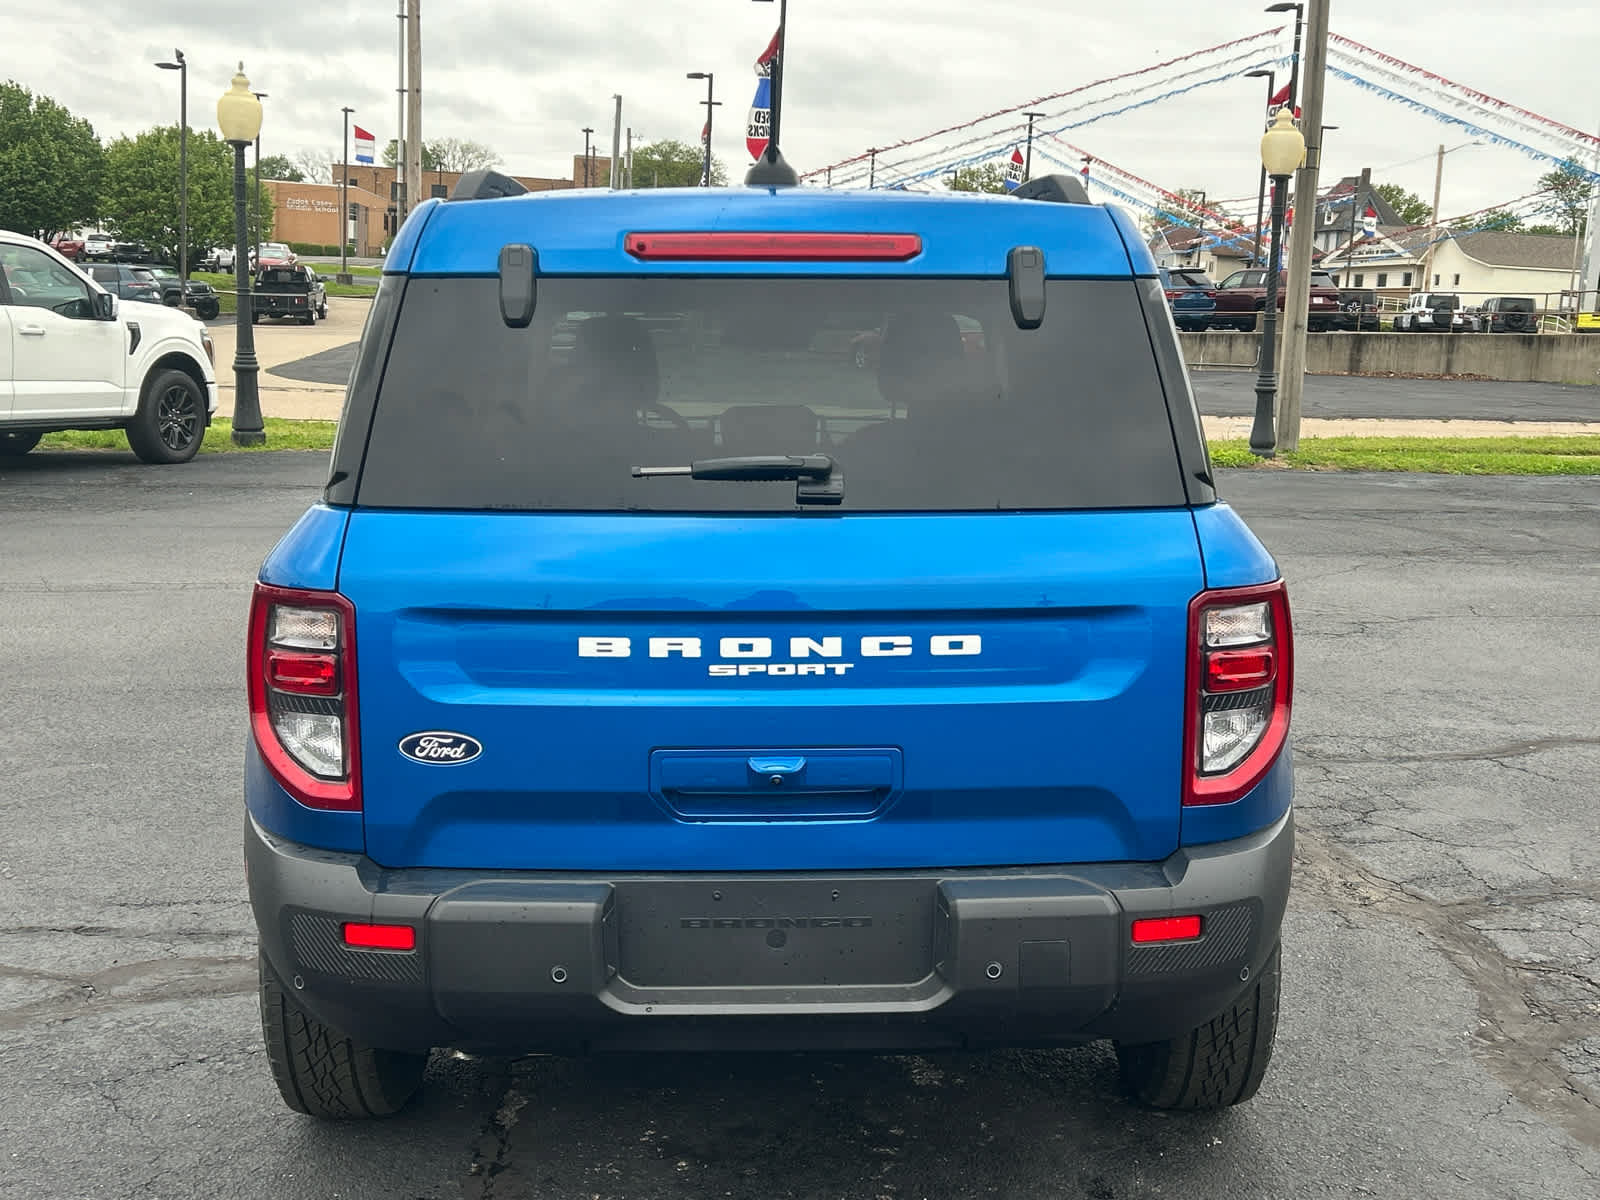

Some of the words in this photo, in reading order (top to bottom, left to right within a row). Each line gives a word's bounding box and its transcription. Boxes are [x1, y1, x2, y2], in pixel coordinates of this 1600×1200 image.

[578, 635, 982, 658] BRONCO
[708, 663, 854, 677] SPORT
[415, 736, 466, 758] Ford
[679, 917, 873, 929] BRONCO
